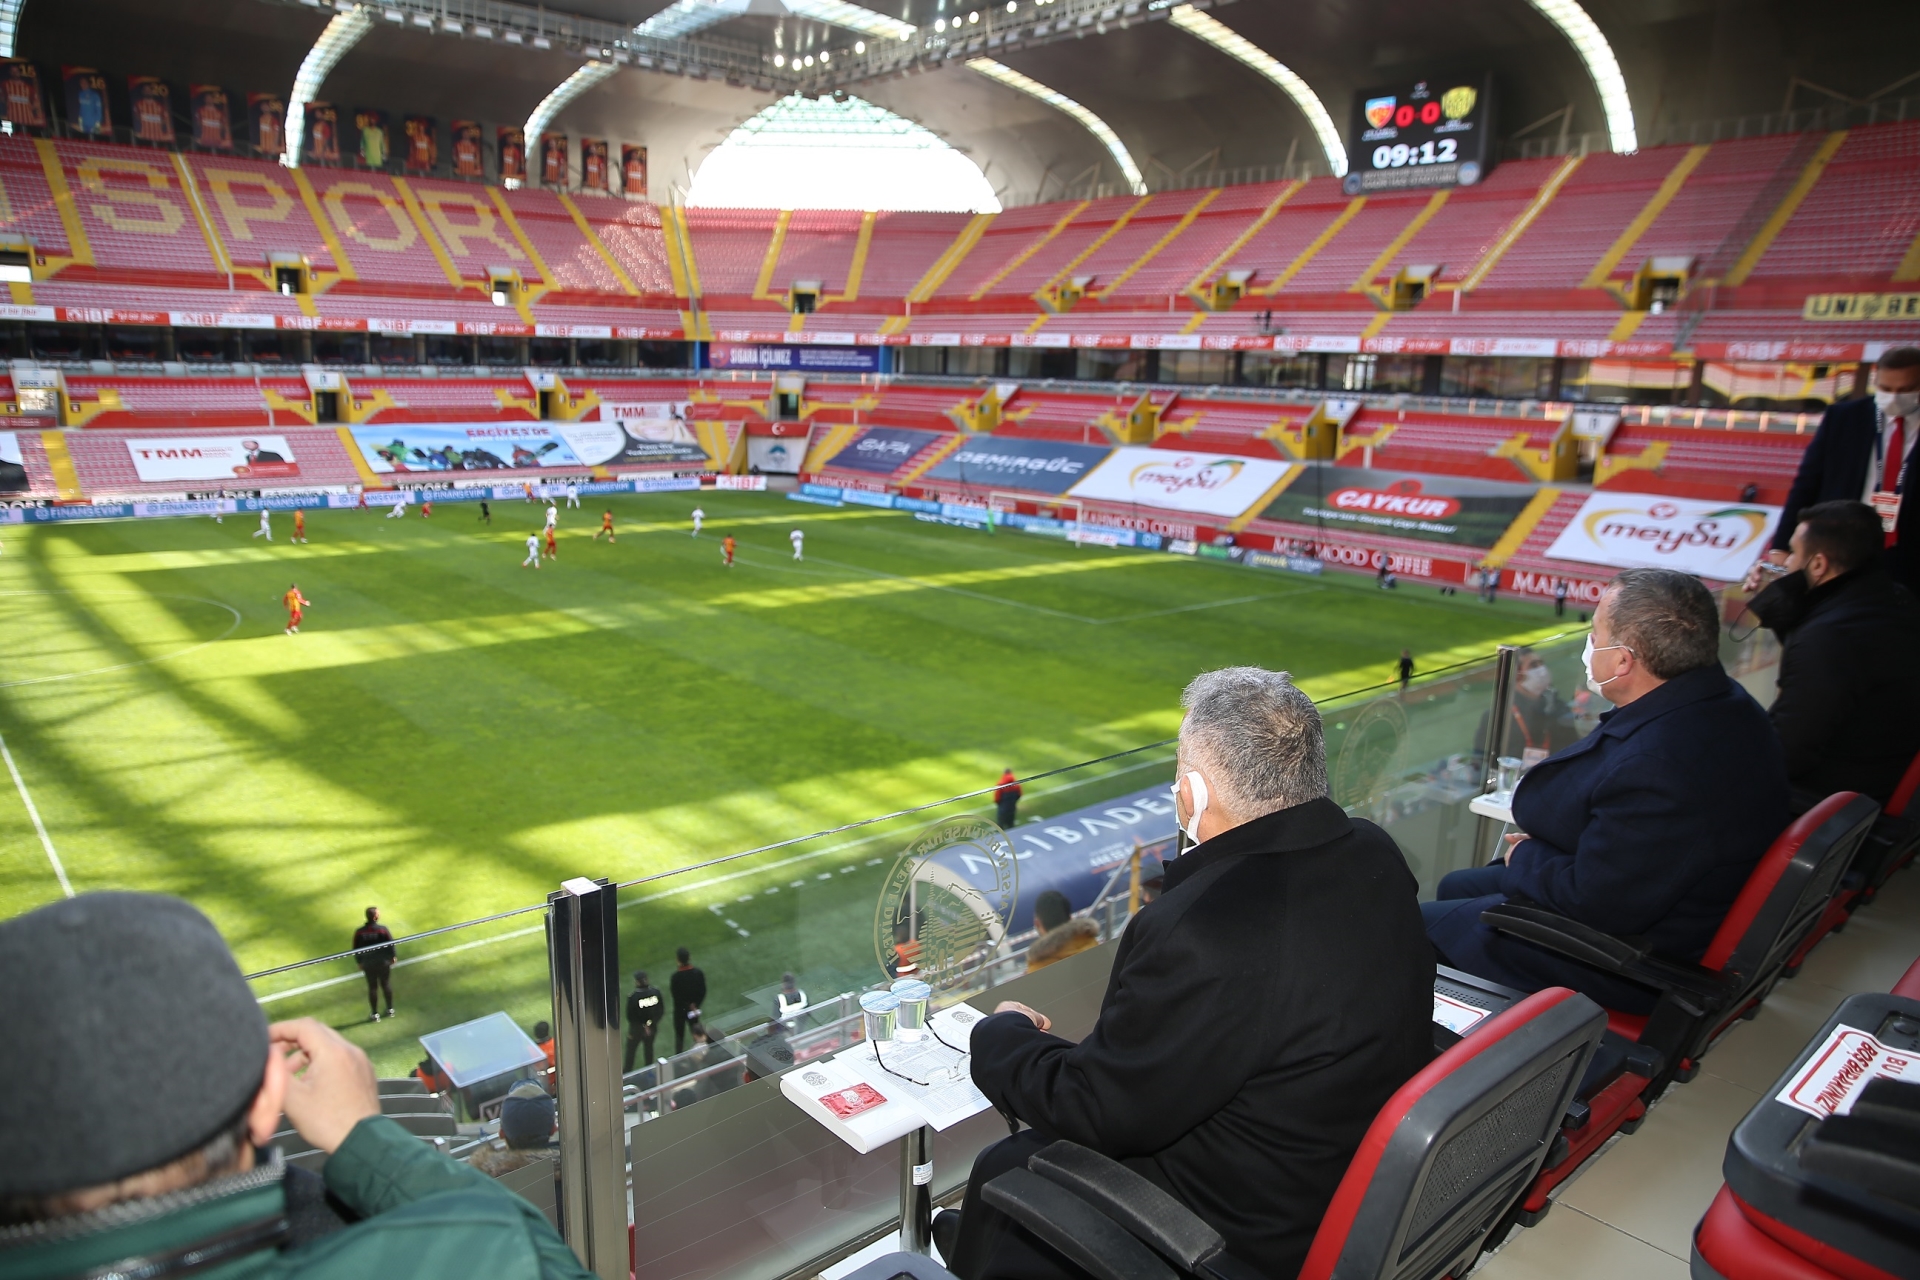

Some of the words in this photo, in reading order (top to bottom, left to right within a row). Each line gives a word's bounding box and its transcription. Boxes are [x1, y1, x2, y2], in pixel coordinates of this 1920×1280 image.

[1372, 138, 1458, 169] 09:12
[613, 406, 646, 418] TMM
[135, 448, 203, 460] TMM
[1336, 490, 1450, 518] ÇAYKUR
